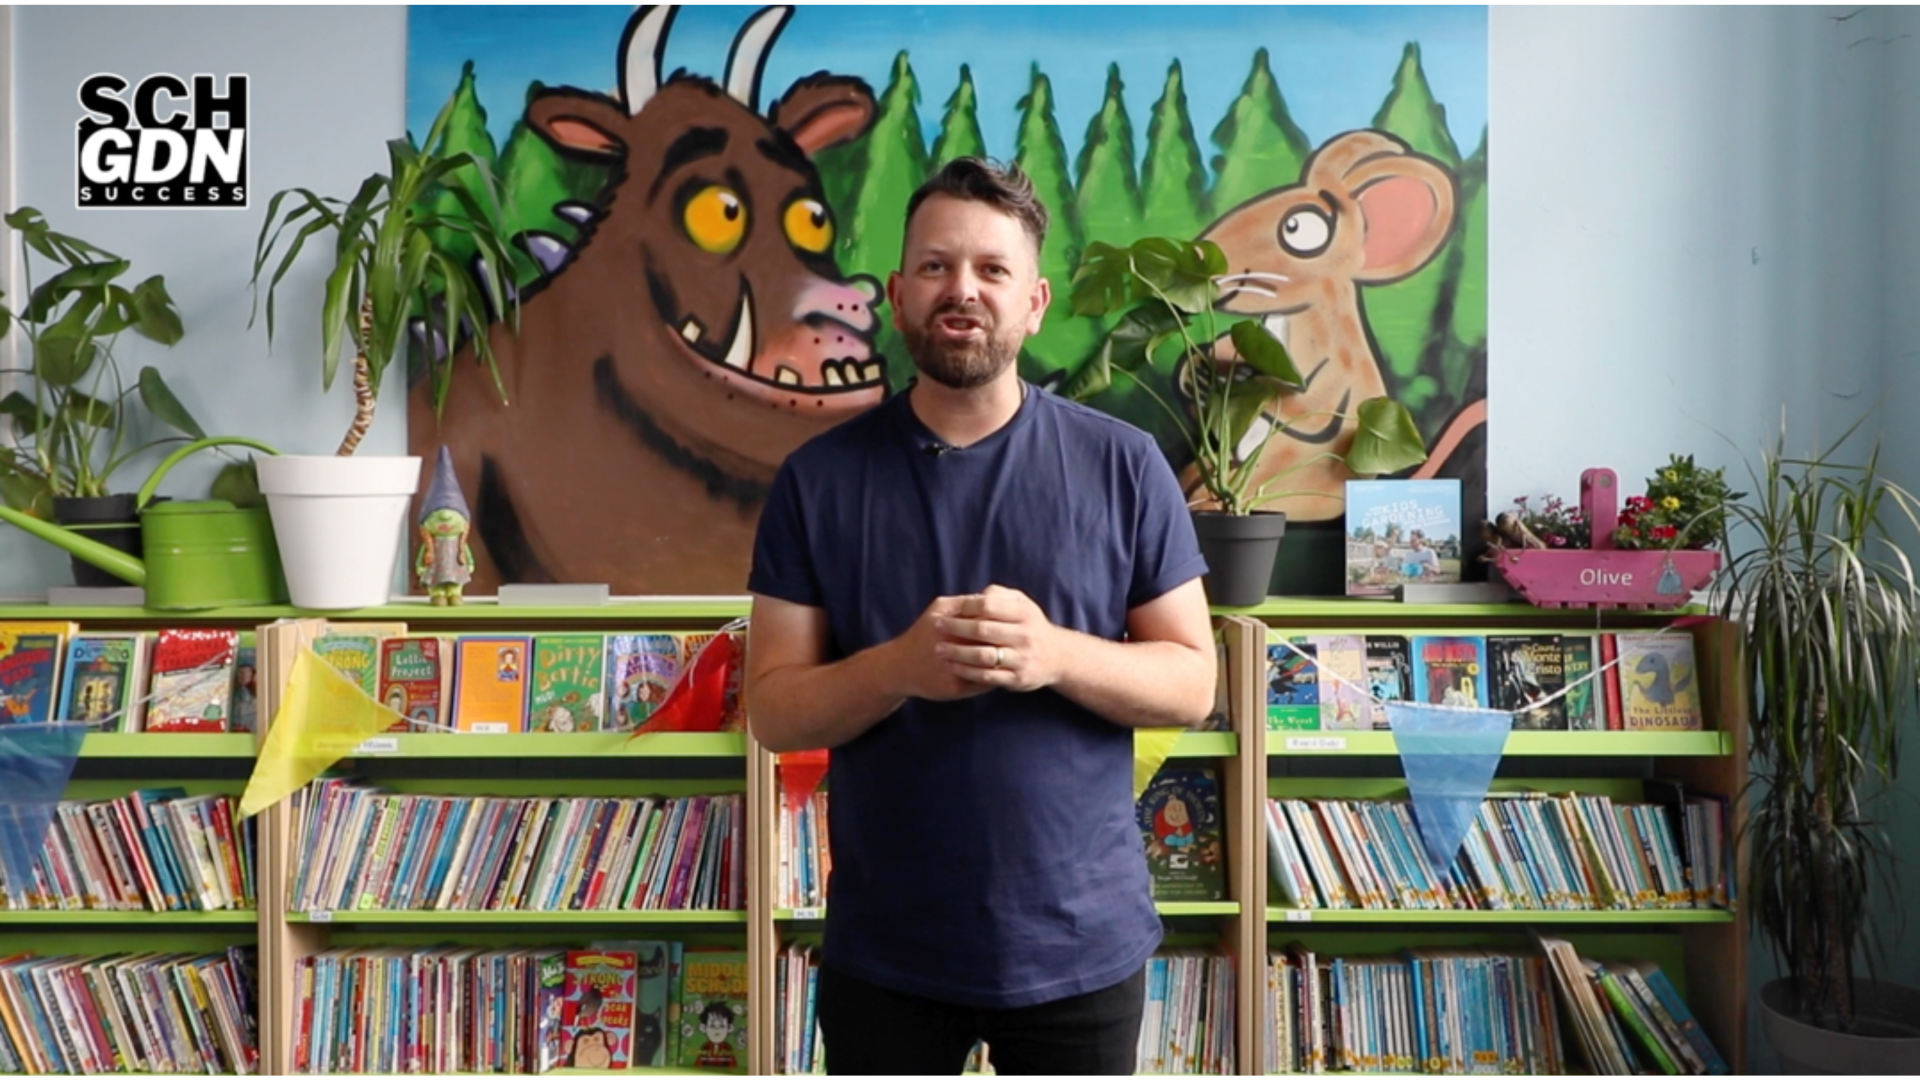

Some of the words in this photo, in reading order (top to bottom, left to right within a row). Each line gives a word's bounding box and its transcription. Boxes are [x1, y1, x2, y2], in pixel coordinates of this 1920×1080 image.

[1382, 499, 1418, 514] KIDS
[1362, 505, 1444, 529] GARDENING
[1580, 568, 1633, 586] Olive
[1374, 641, 1400, 649] WILLIS
[1532, 643, 1555, 651] Count
[322, 650, 370, 669] TRONG
[540, 644, 600, 669] Dirty
[1524, 651, 1562, 663] Monte
[391, 665, 432, 678] Project
[1529, 663, 1562, 675] Cristo
[537, 665, 599, 692] Bertie
[1629, 716, 1699, 727] DINOSAUR
